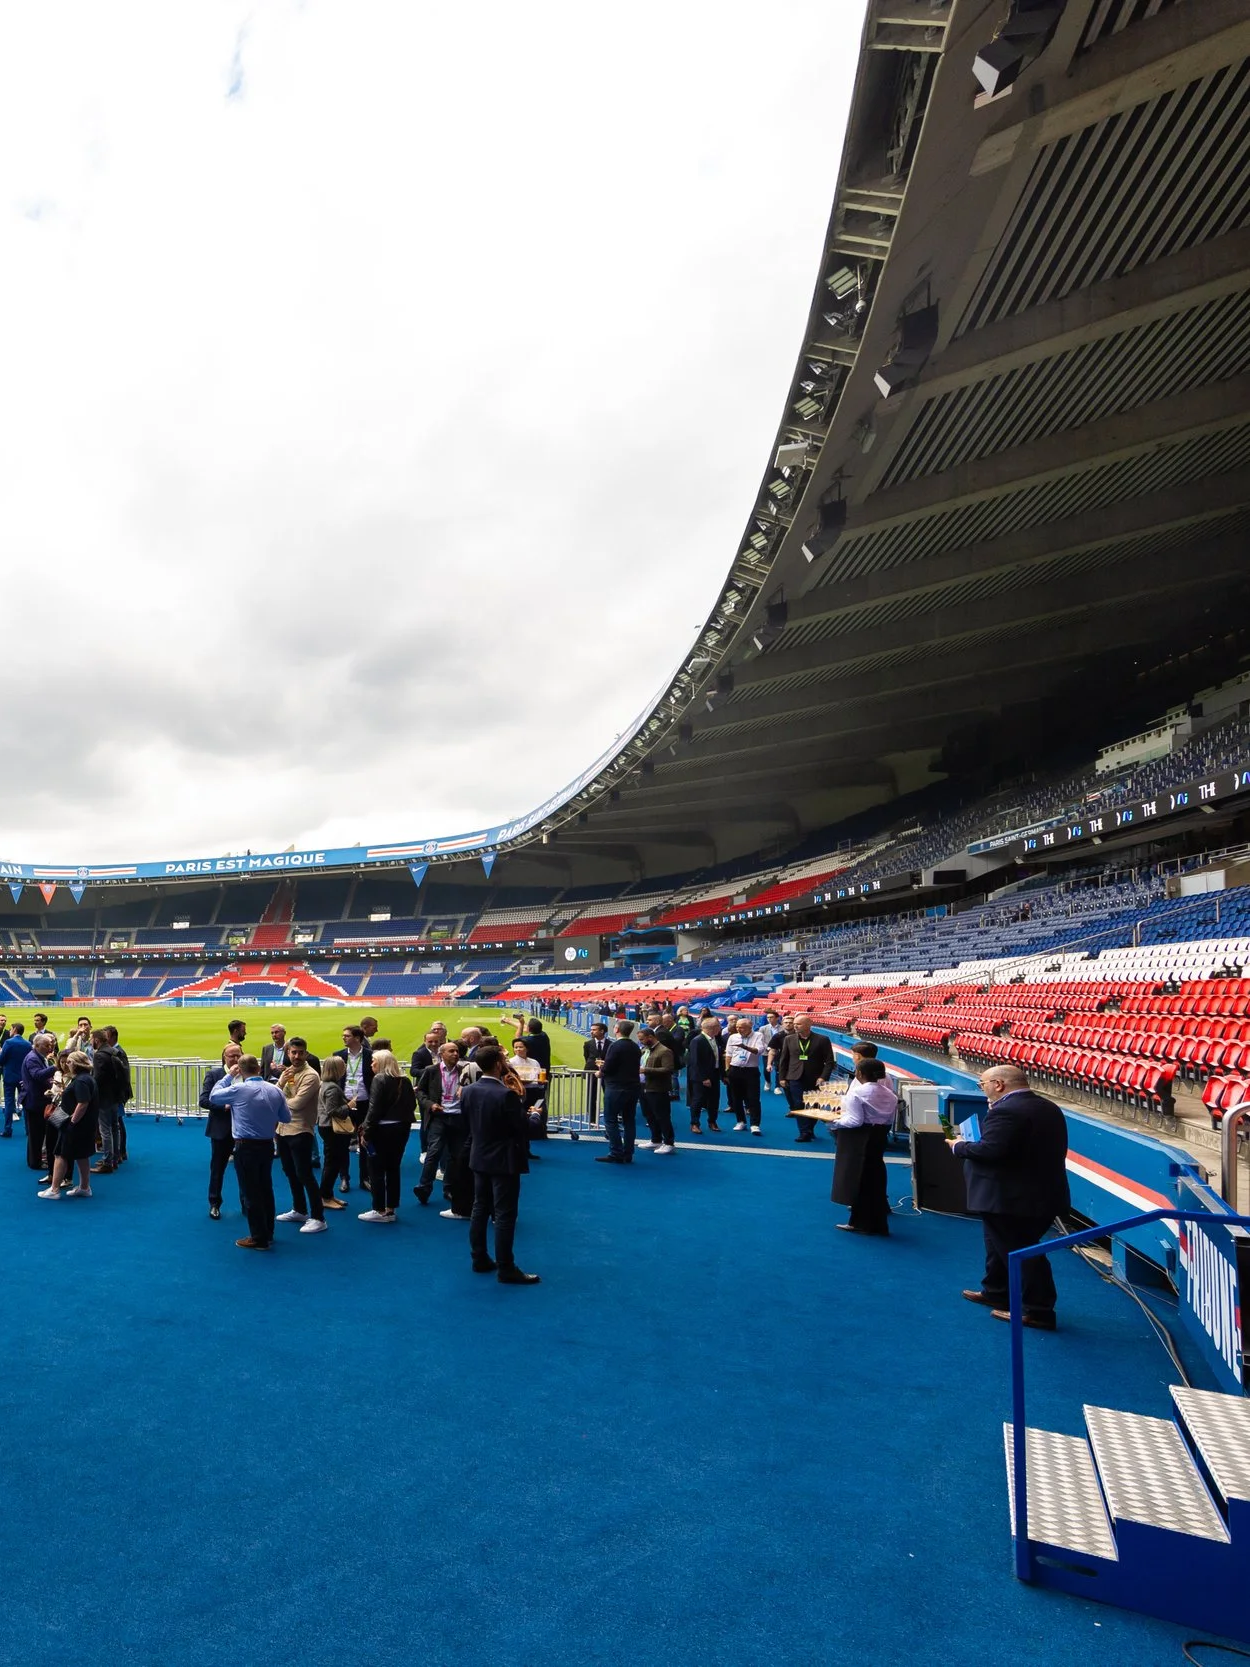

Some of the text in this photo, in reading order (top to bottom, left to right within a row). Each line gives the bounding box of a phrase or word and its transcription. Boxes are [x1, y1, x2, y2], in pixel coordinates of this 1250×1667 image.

[165, 852, 326, 874] PARIS EST MAGIQUE
[1185, 1220, 1241, 1384] TRIBUNE
